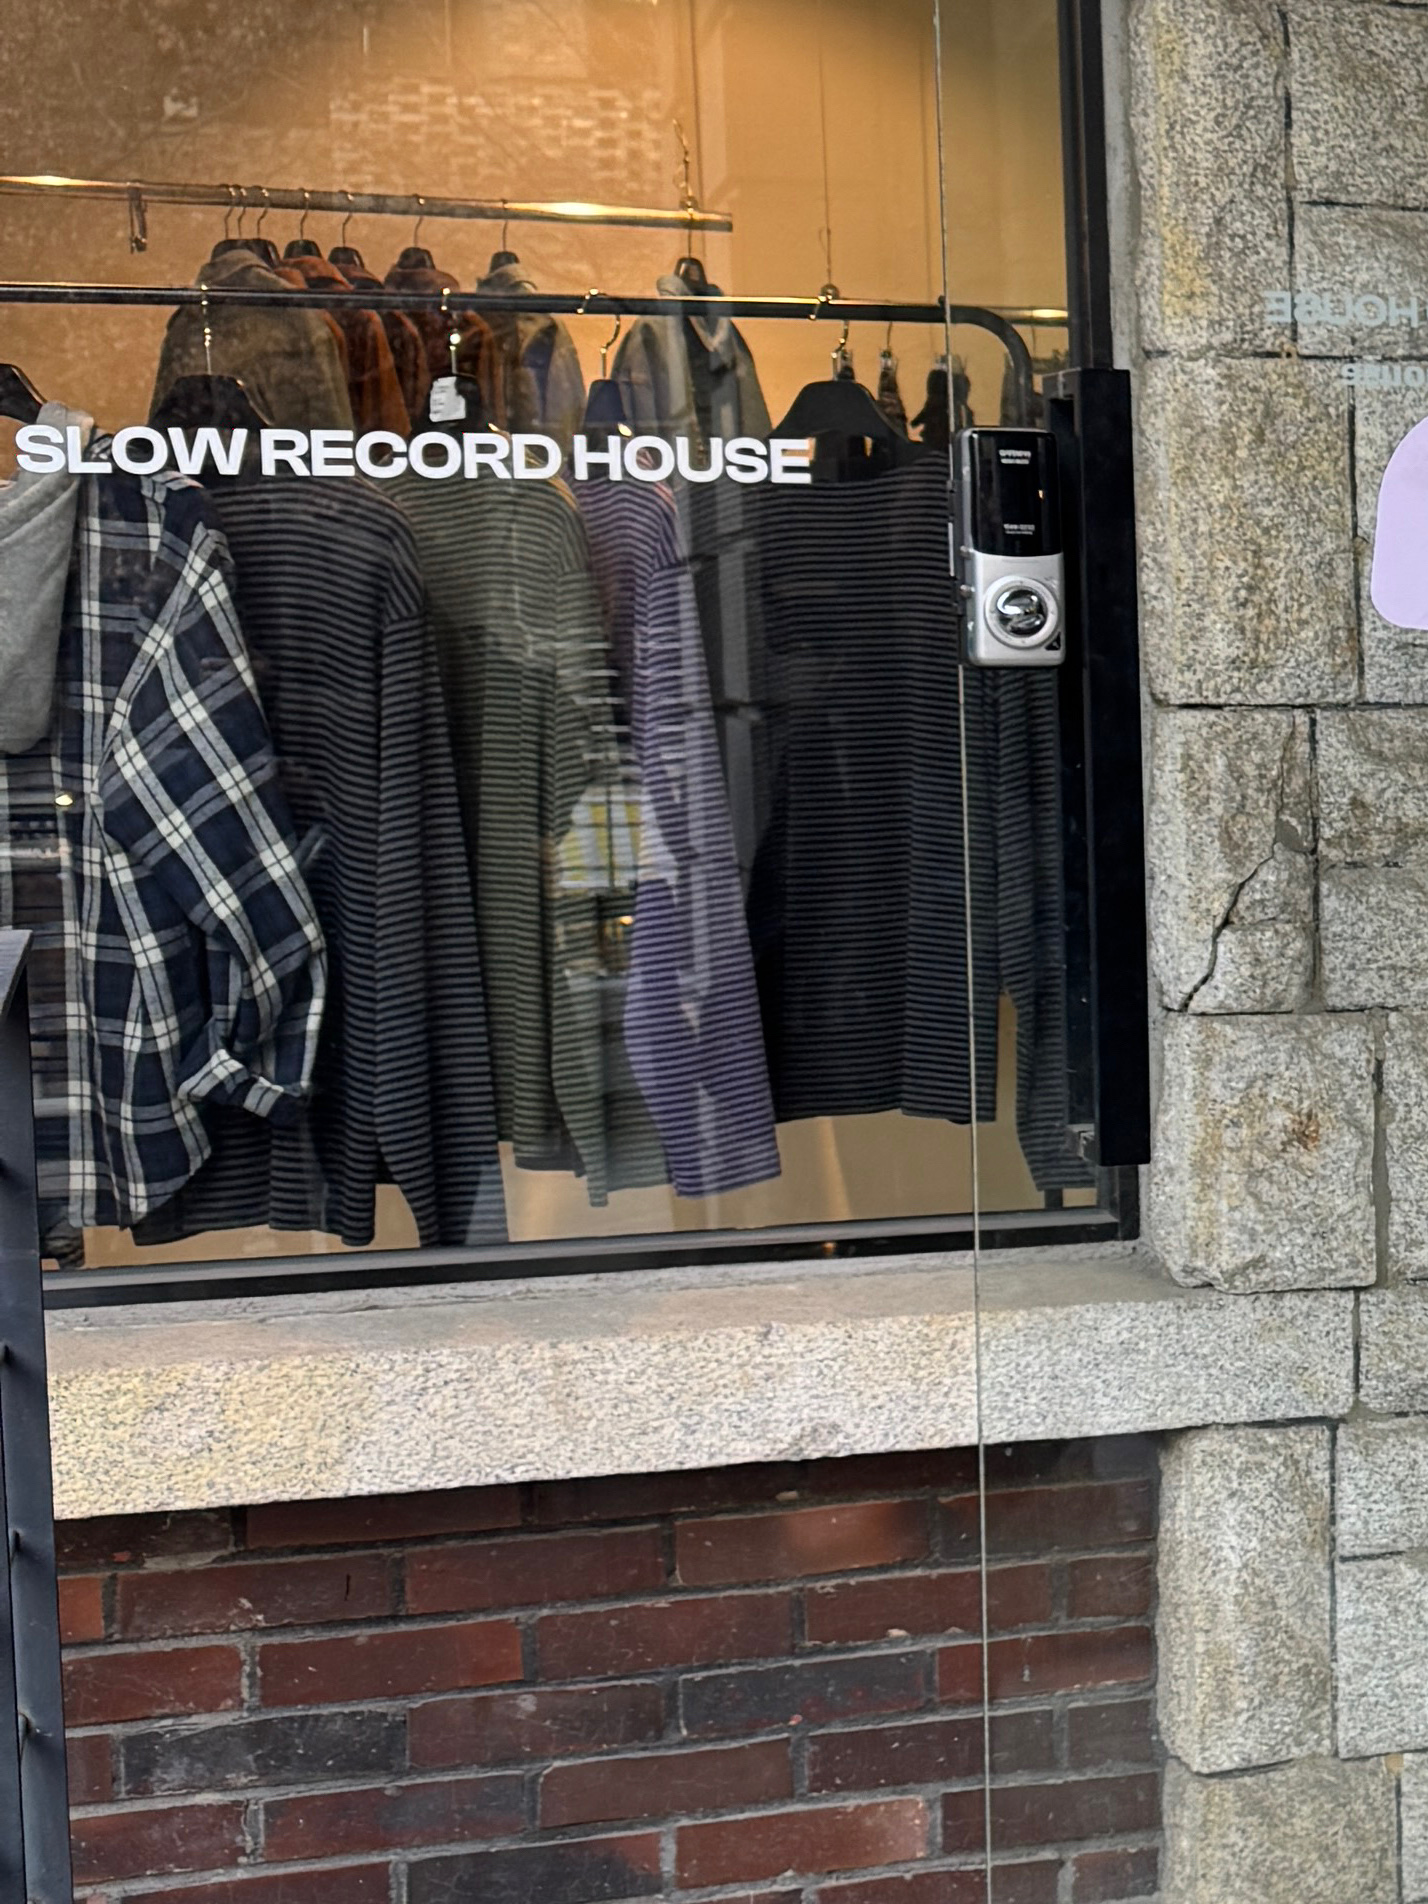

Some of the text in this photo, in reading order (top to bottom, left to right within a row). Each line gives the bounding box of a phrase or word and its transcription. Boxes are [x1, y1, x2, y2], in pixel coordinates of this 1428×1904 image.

[15, 425, 812, 484] SLOW RECORD HOUSE
